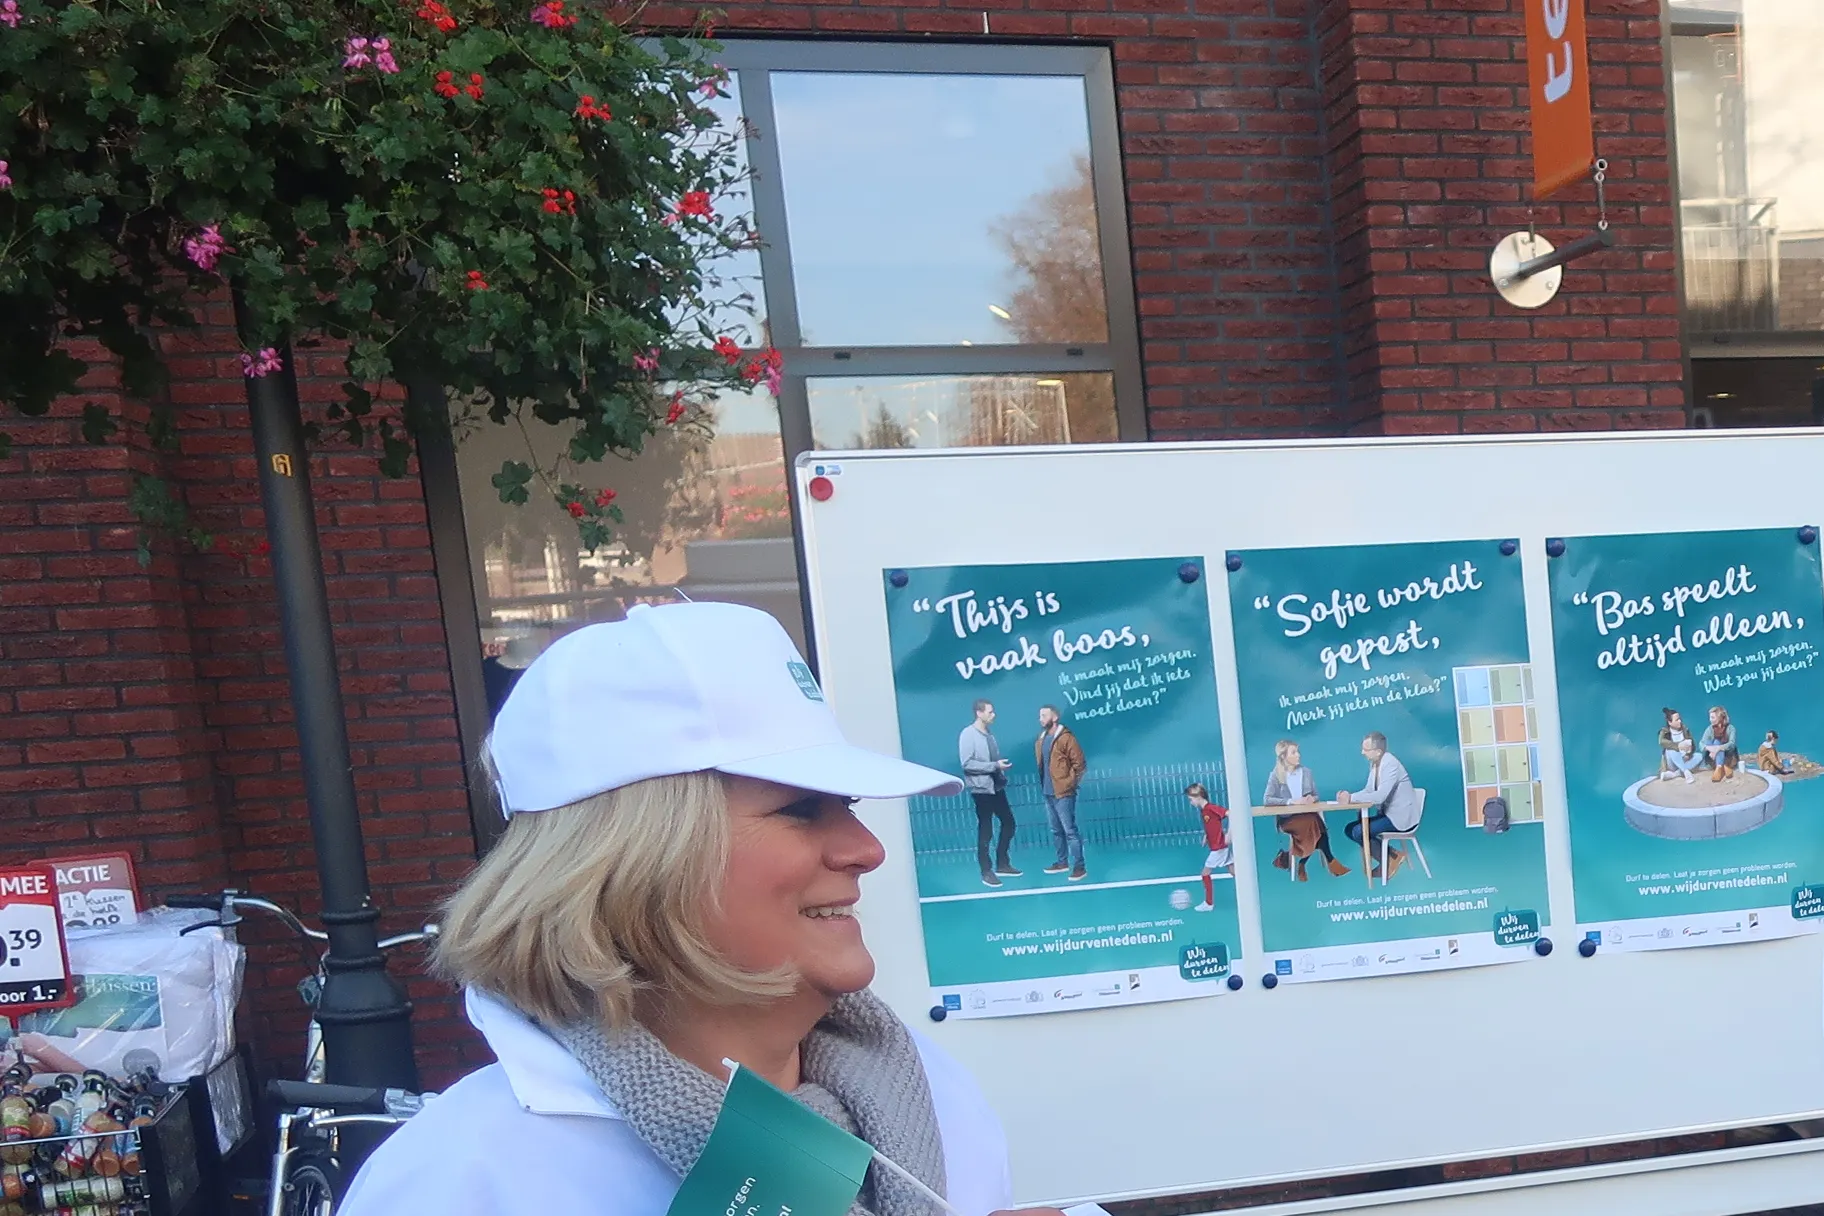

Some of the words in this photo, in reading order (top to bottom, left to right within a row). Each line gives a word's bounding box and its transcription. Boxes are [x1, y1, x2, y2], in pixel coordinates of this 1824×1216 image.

[1377, 560, 1483, 609] wordt
[1661, 564, 1757, 618] speelt
[1035, 590, 1060, 616] is
[1320, 619, 1441, 680] gepest,
[1597, 624, 1686, 668] altijd
[1691, 610, 1805, 649] alleen,
[955, 636, 1047, 680] vaak
[1053, 625, 1150, 662] boos,
[1694, 662, 1707, 676] ik
[1708, 655, 1744, 672] maak
[1745, 650, 1767, 665] mij
[1769, 641, 1814, 660] zorgen.
[1074, 662, 1116, 683] maak
[1117, 656, 1143, 675] mij
[1146, 649, 1197, 668] zorgen.
[1063, 686, 1103, 707] Vind
[1105, 682, 1122, 702] jij
[1123, 674, 1149, 692] dat
[1150, 670, 1164, 686] ik
[1166, 667, 1191, 682] iets
[1294, 686, 1333, 704] maak
[1335, 680, 1359, 696] mij
[1361, 672, 1410, 692] zorgen.
[1703, 674, 1734, 694] Wat
[1736, 671, 1759, 688] zou
[1761, 665, 1775, 681] jij
[1074, 704, 1114, 721] moet
[1286, 706, 1327, 730] Merk
[1328, 703, 1344, 720] jij
[1346, 697, 1369, 712] iets
[1372, 695, 1384, 706] in
[1386, 688, 1403, 702] de
[56, 864, 111, 886] ACTIE
[1625, 874, 1641, 882] Durf
[1674, 870, 1688, 879] Laat
[1698, 868, 1721, 878] zorgen
[1722, 867, 1739, 876] geen
[1740, 864, 1771, 874] probleem
[1772, 861, 1797, 870] worden.
[0, 875, 49, 897] MEE
[1638, 872, 1788, 896] www.wijdurventedelen.nl
[1798, 888, 1813, 900] Wij
[1316, 900, 1333, 909] Durf
[1343, 897, 1365, 906] delen.
[1366, 895, 1383, 904] Laat
[1393, 893, 1419, 903] zorgen
[1419, 891, 1437, 900] geen
[1437, 888, 1470, 899] probleem
[1471, 885, 1498, 895] worden.
[1795, 898, 1821, 908] durven
[1330, 897, 1489, 922] www.wijdurventedelen.nl
[1501, 913, 1519, 926] Wij
[986, 933, 1004, 942] Durf
[1005, 932, 1014, 940] te
[1015, 930, 1040, 940] delen.
[1041, 928, 1059, 938] Laat
[1068, 925, 1096, 936] zorgen
[1097, 924, 1116, 935] geen
[1117, 920, 1153, 932] probleem
[1154, 917, 1185, 927] worden.
[1498, 923, 1530, 936] durven
[1504, 934, 1514, 944] te
[1002, 930, 1173, 957] www.wijdurventedelen.nl
[1187, 946, 1206, 961] Wij
[1183, 956, 1219, 970] durven
[1191, 967, 1202, 978] te
[0, 990, 27, 1003] oor
